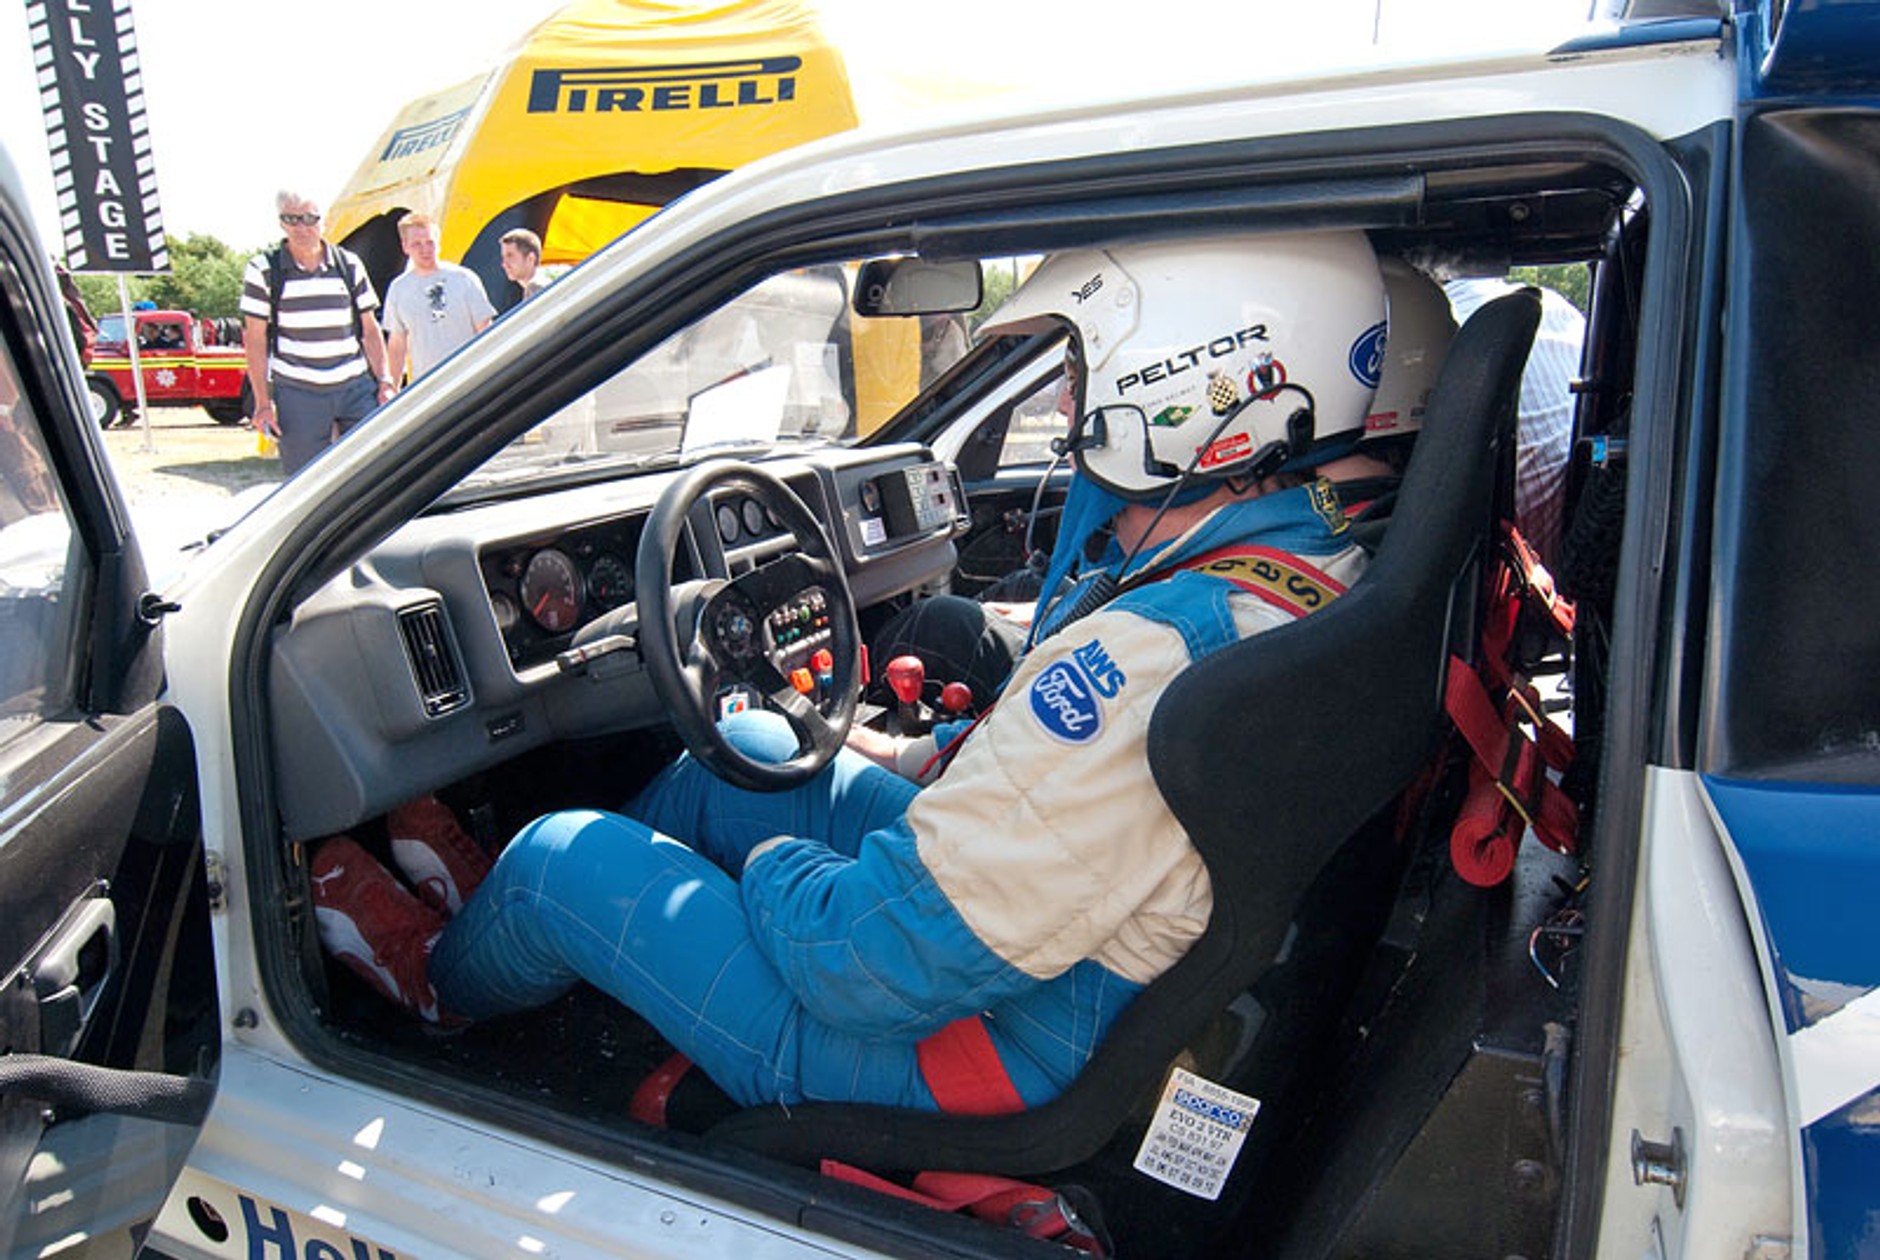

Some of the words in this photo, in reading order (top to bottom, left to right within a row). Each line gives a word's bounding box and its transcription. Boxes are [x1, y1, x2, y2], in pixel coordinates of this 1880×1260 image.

[526, 55, 803, 114] PIRELLI
[82, 102, 130, 260] STAGE
[1116, 323, 1270, 396] PELTOR
[1194, 558, 1323, 608] Sab
[1034, 667, 1094, 732] Ford
